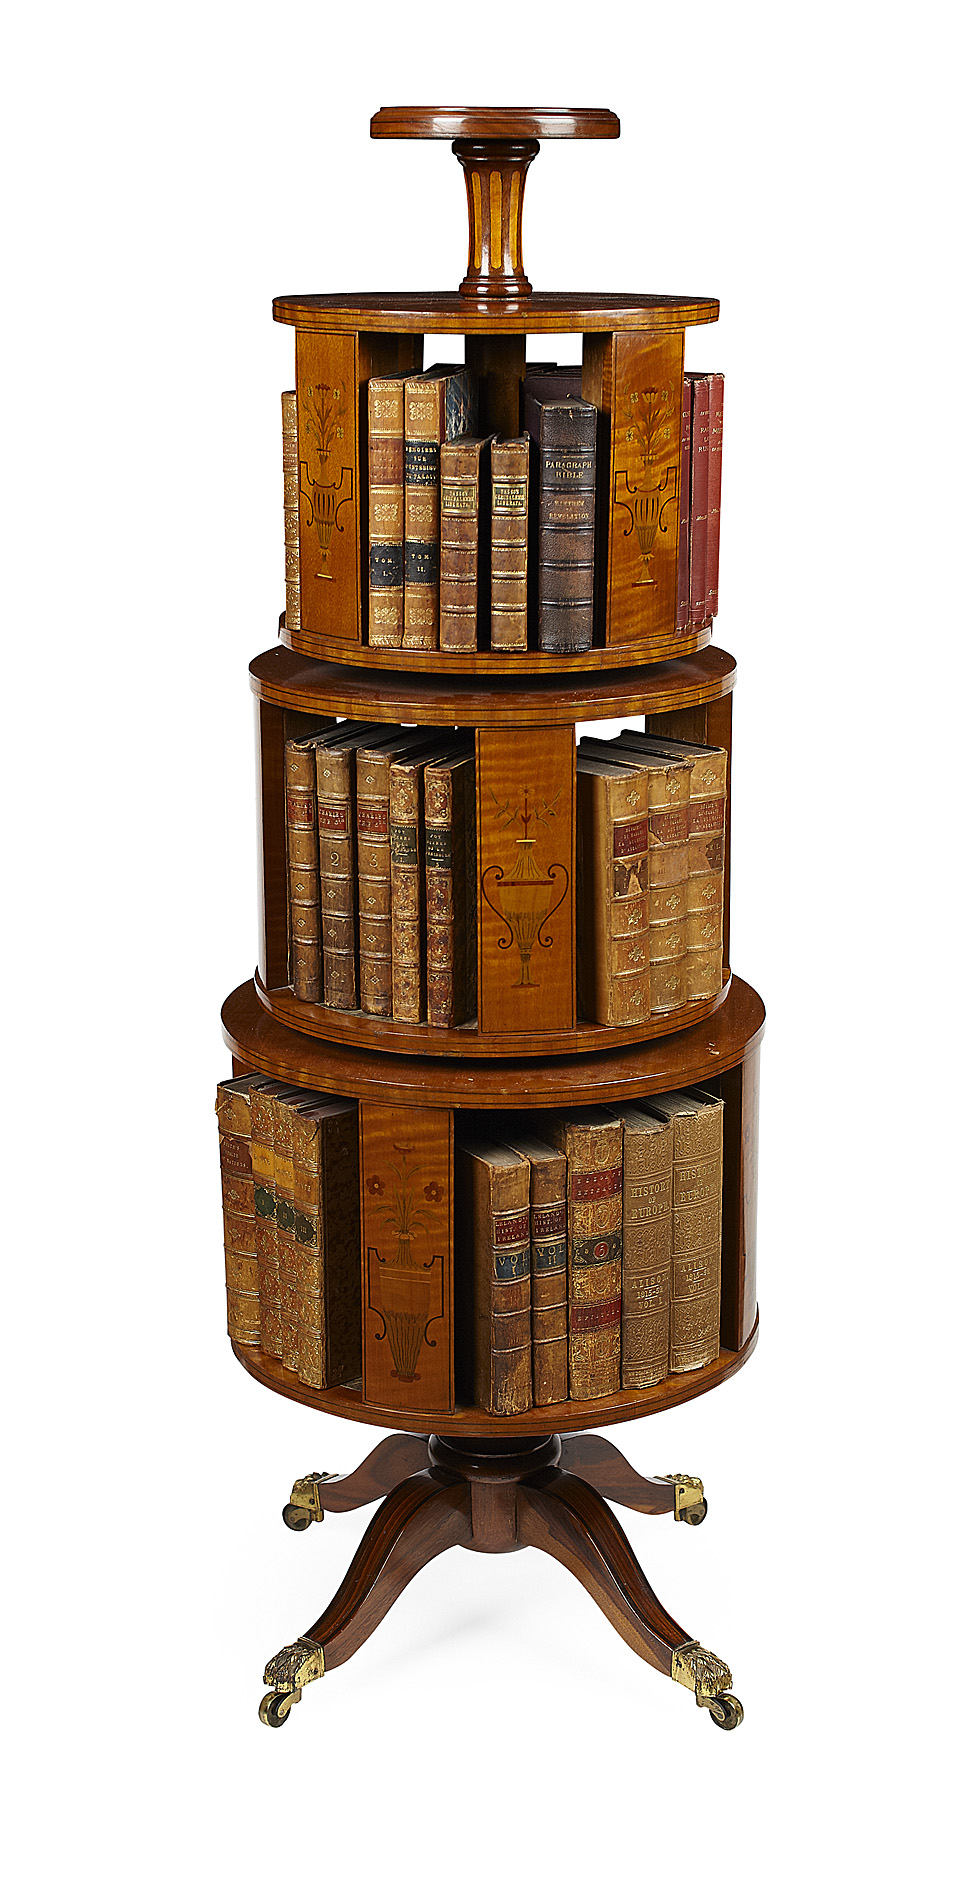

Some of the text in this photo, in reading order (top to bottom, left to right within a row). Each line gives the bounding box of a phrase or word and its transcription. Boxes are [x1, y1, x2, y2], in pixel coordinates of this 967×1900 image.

[545, 460, 593, 469] PARAGRAPH
[555, 471, 584, 479] BIBLE
[330, 852, 340, 867] 2
[369, 853, 379, 868] 3
[680, 1161, 717, 1182] HISTORY
[631, 1180, 670, 1198] HISTORY
[648, 1196, 656, 1204] OF
[631, 1200, 670, 1219] EUROPE
[548, 1255, 557, 1265] II
